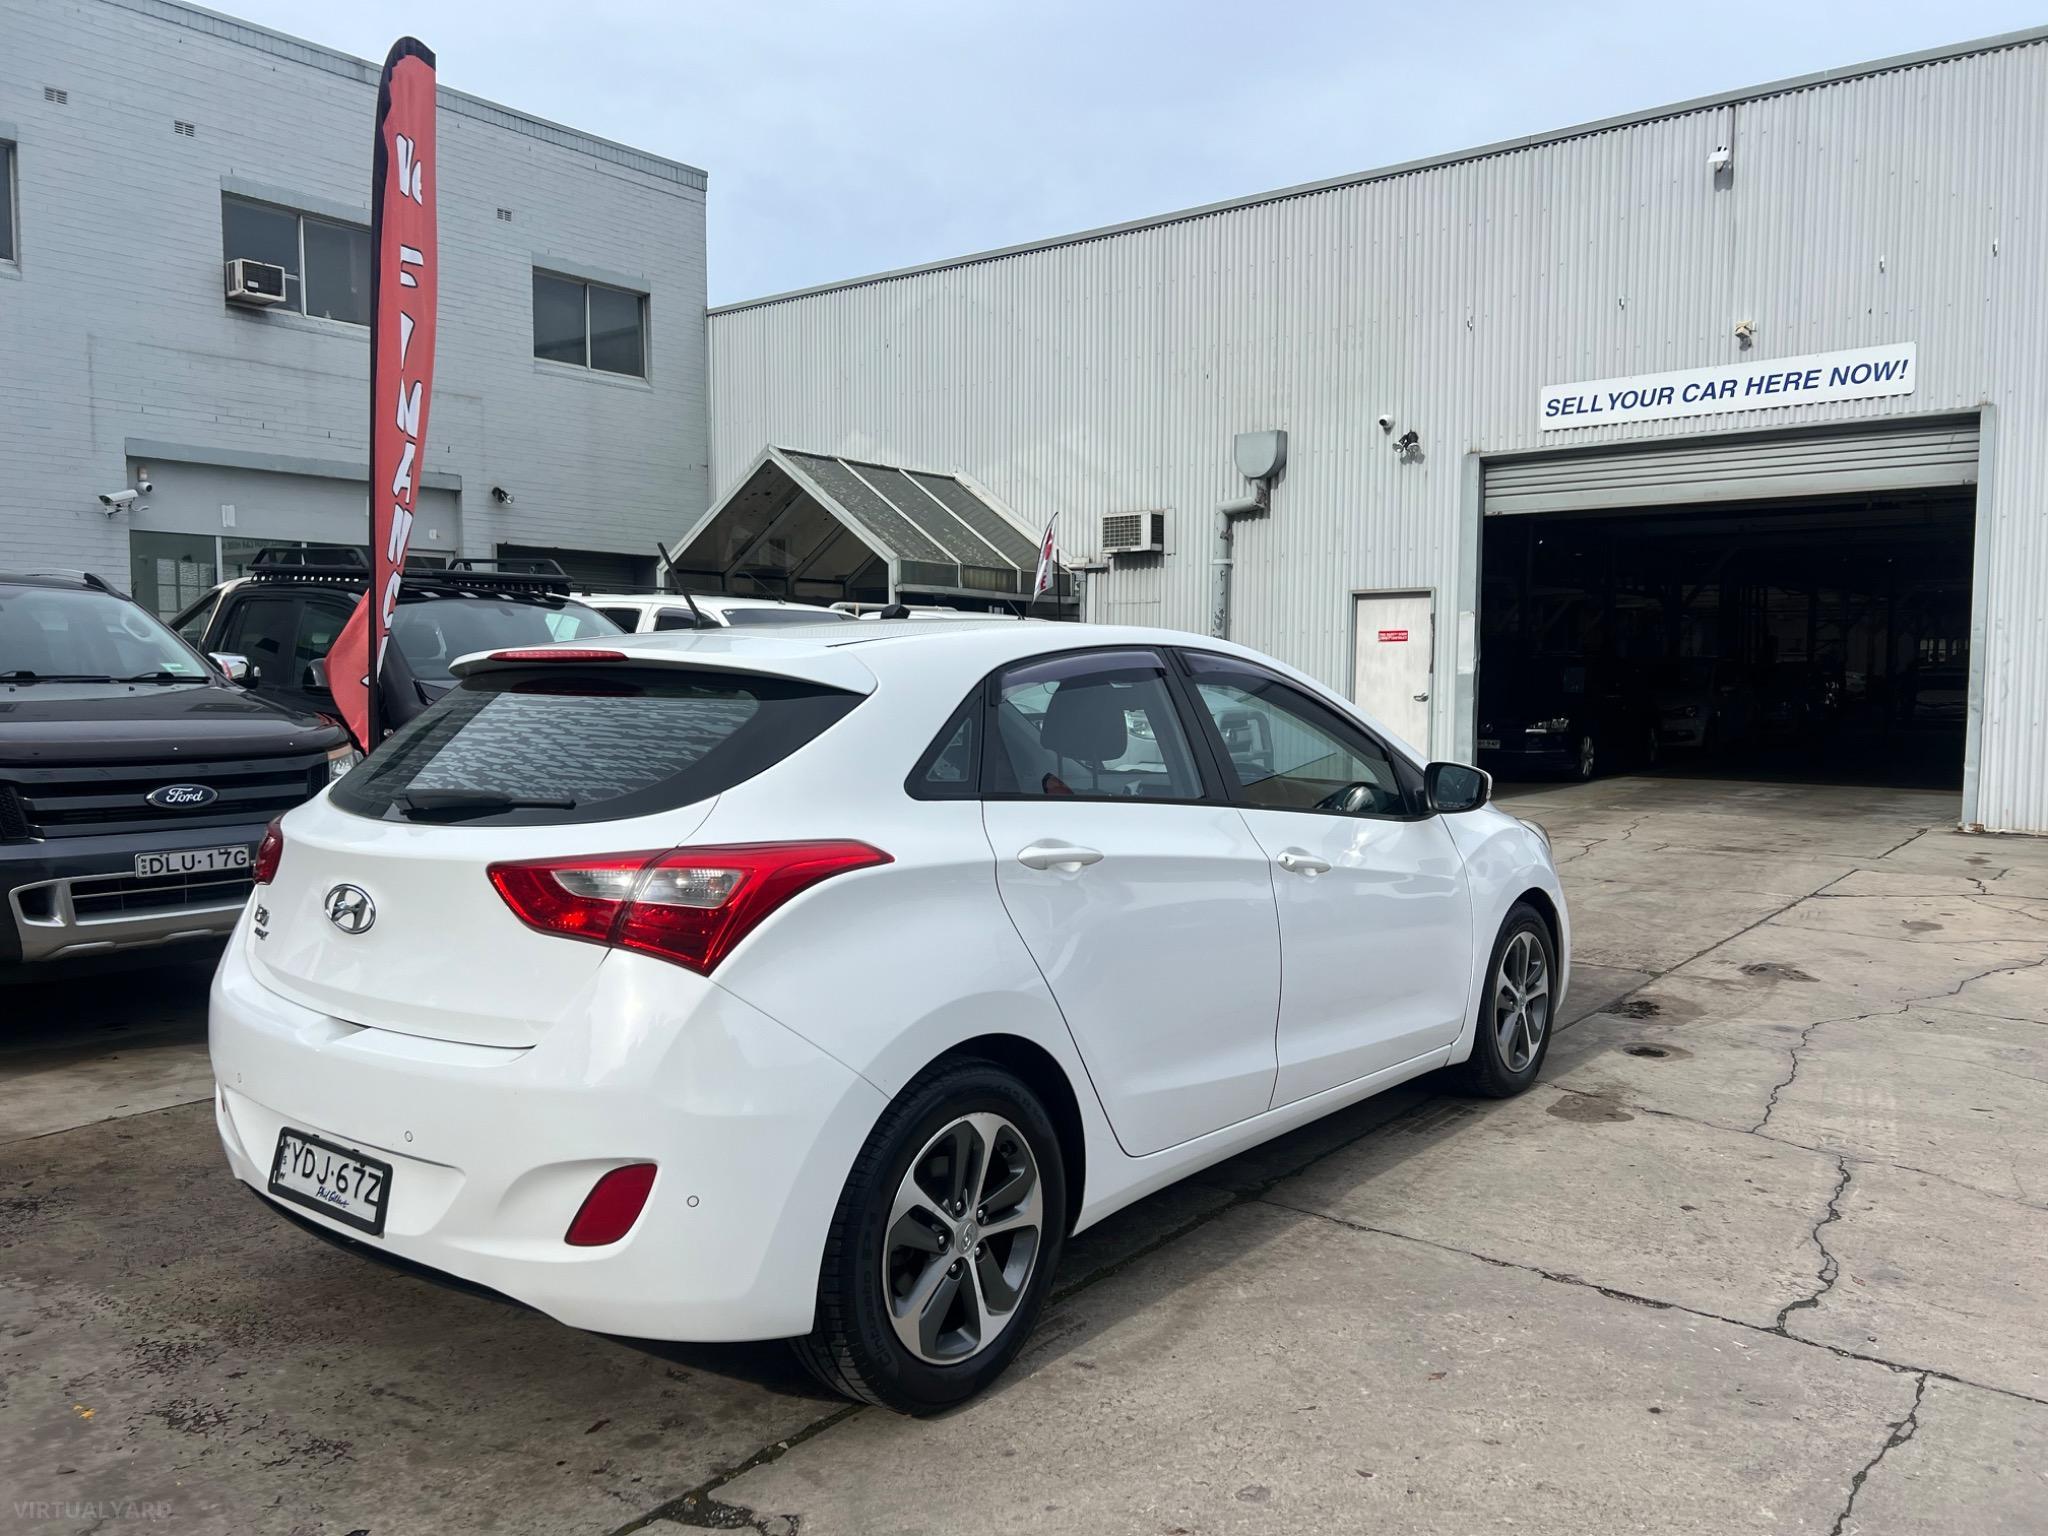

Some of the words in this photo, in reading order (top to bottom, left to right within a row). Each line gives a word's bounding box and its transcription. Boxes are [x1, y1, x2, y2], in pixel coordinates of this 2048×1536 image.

[1545, 394, 1604, 417] SELL
[1607, 387, 1675, 410] YOUR
[1682, 379, 1738, 403] CAR
[1745, 369, 1822, 397] HERE
[1829, 359, 1909, 387] NOW!
[165, 787, 204, 803] Ford
